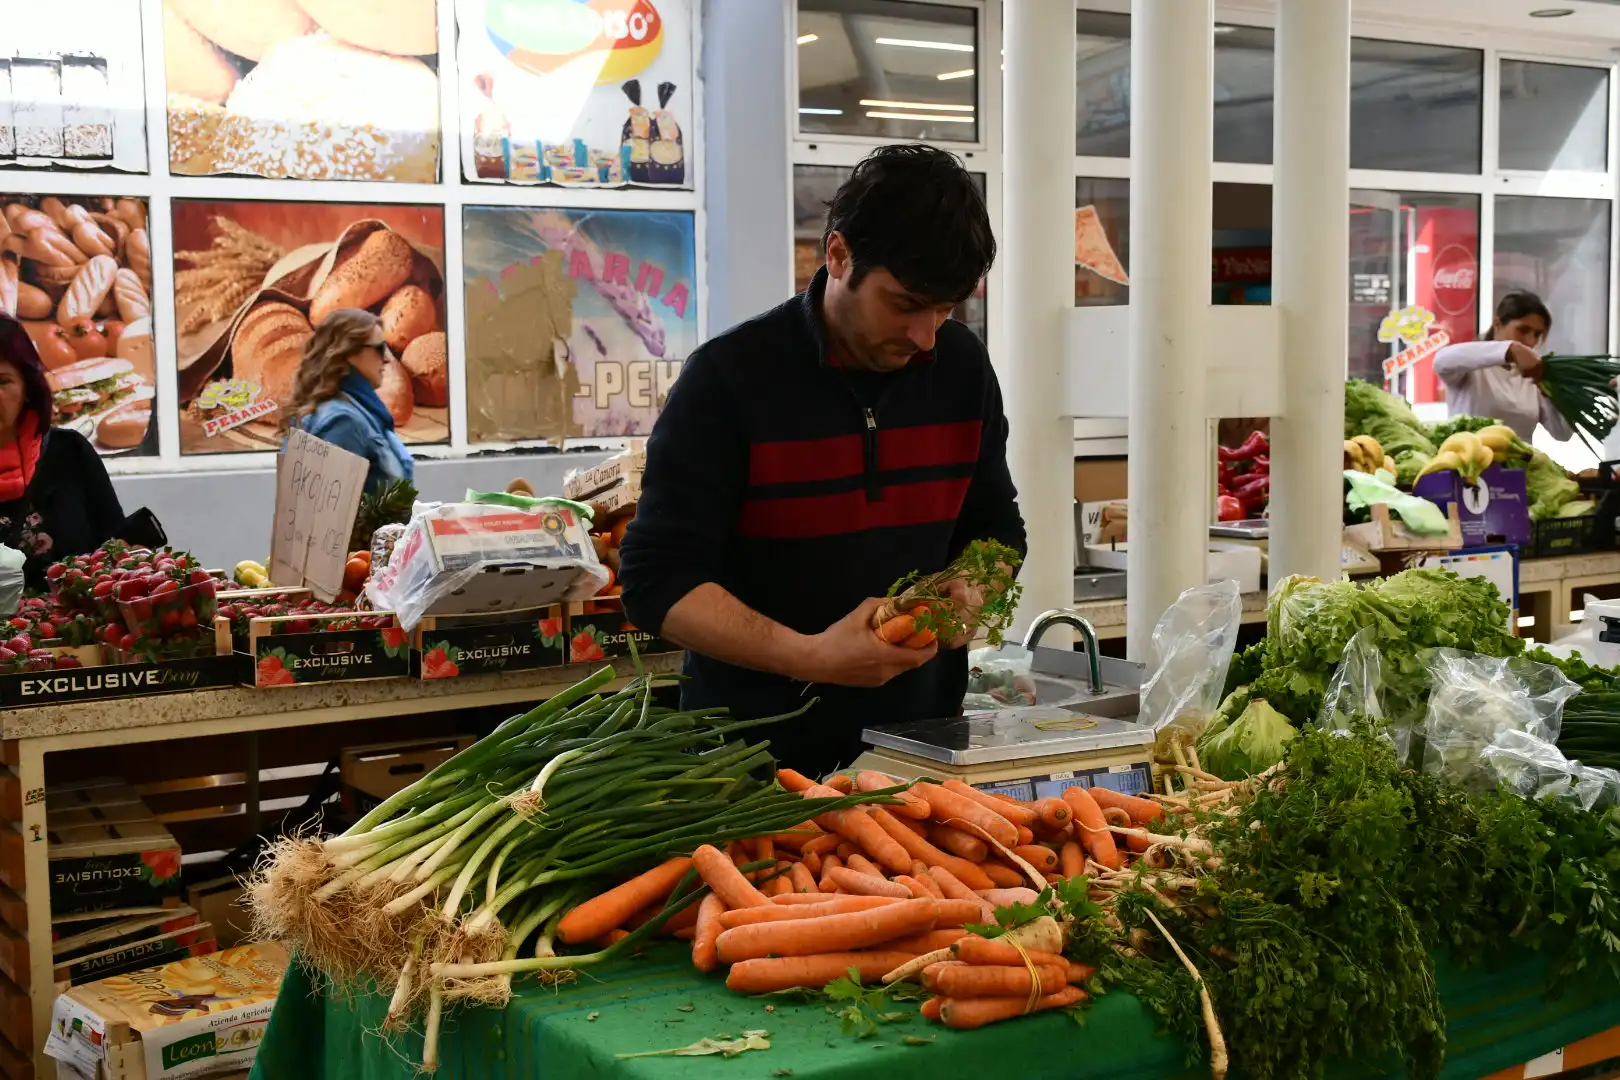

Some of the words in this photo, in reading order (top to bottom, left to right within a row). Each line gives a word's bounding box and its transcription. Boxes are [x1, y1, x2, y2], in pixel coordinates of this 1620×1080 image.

[206, 400, 275, 433] PEKARNA
[293, 654, 373, 669] EXCLUSIVE
[457, 644, 531, 661] EXCLUSIVE
[20, 669, 160, 696] EXCLUSIVE
[56, 866, 142, 884] EXCLUSIVE
[80, 940, 164, 972] EXCLUSIVE
[208, 1014, 238, 1028] Azienda
[241, 1006, 272, 1020] Agricola
[170, 1036, 228, 1062] Leone
